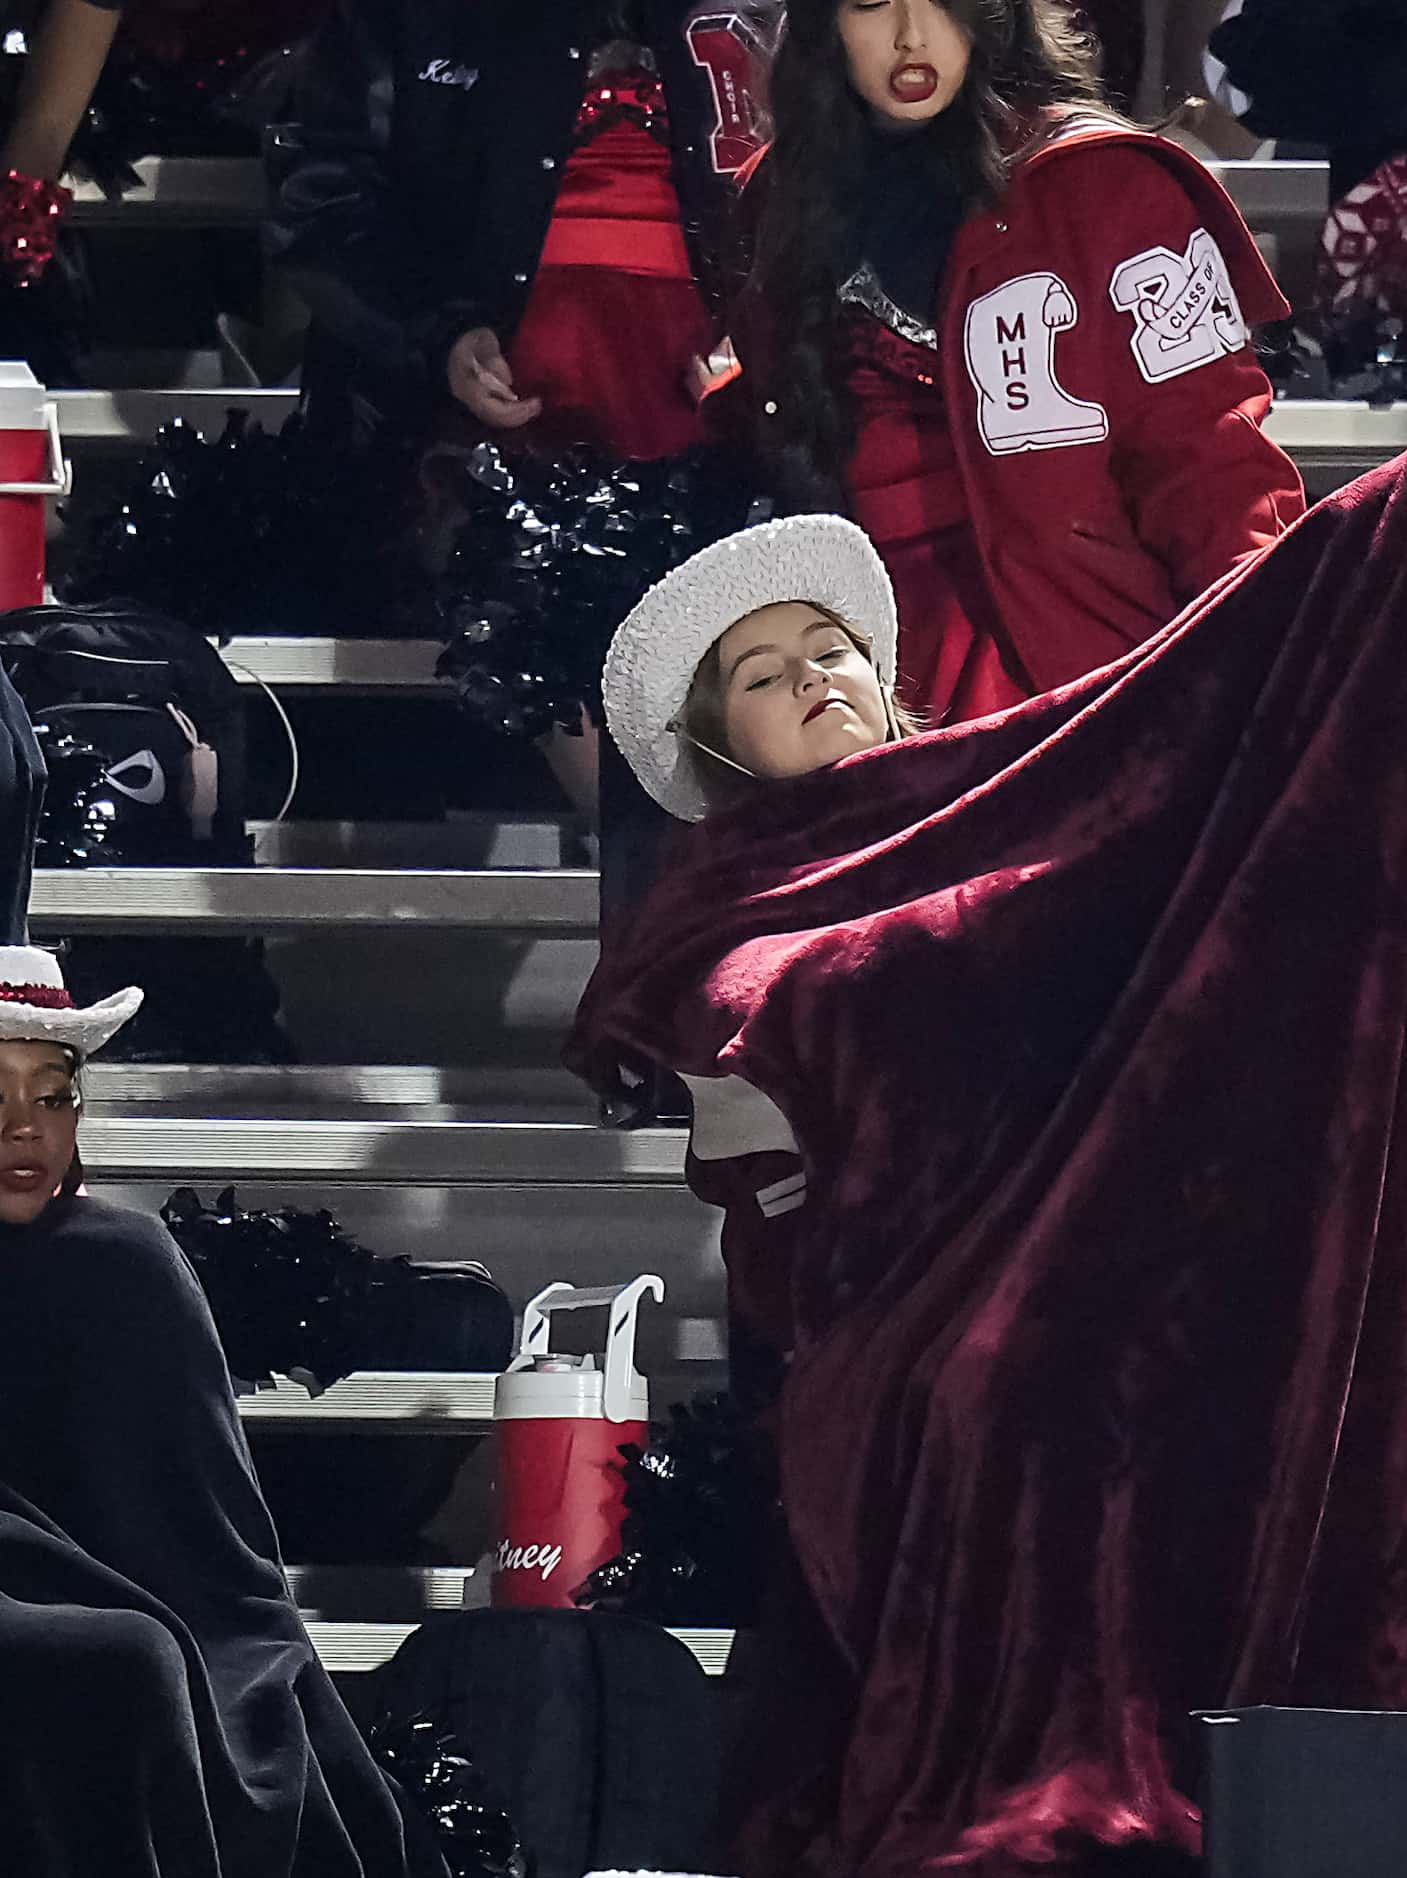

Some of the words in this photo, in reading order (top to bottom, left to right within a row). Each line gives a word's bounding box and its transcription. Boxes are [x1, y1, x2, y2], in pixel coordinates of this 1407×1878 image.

[722, 70, 741, 125] CHOIR
[1169, 283, 1207, 329] CLASS
[1203, 261, 1216, 281] OF
[996, 312, 1030, 411] MHS
